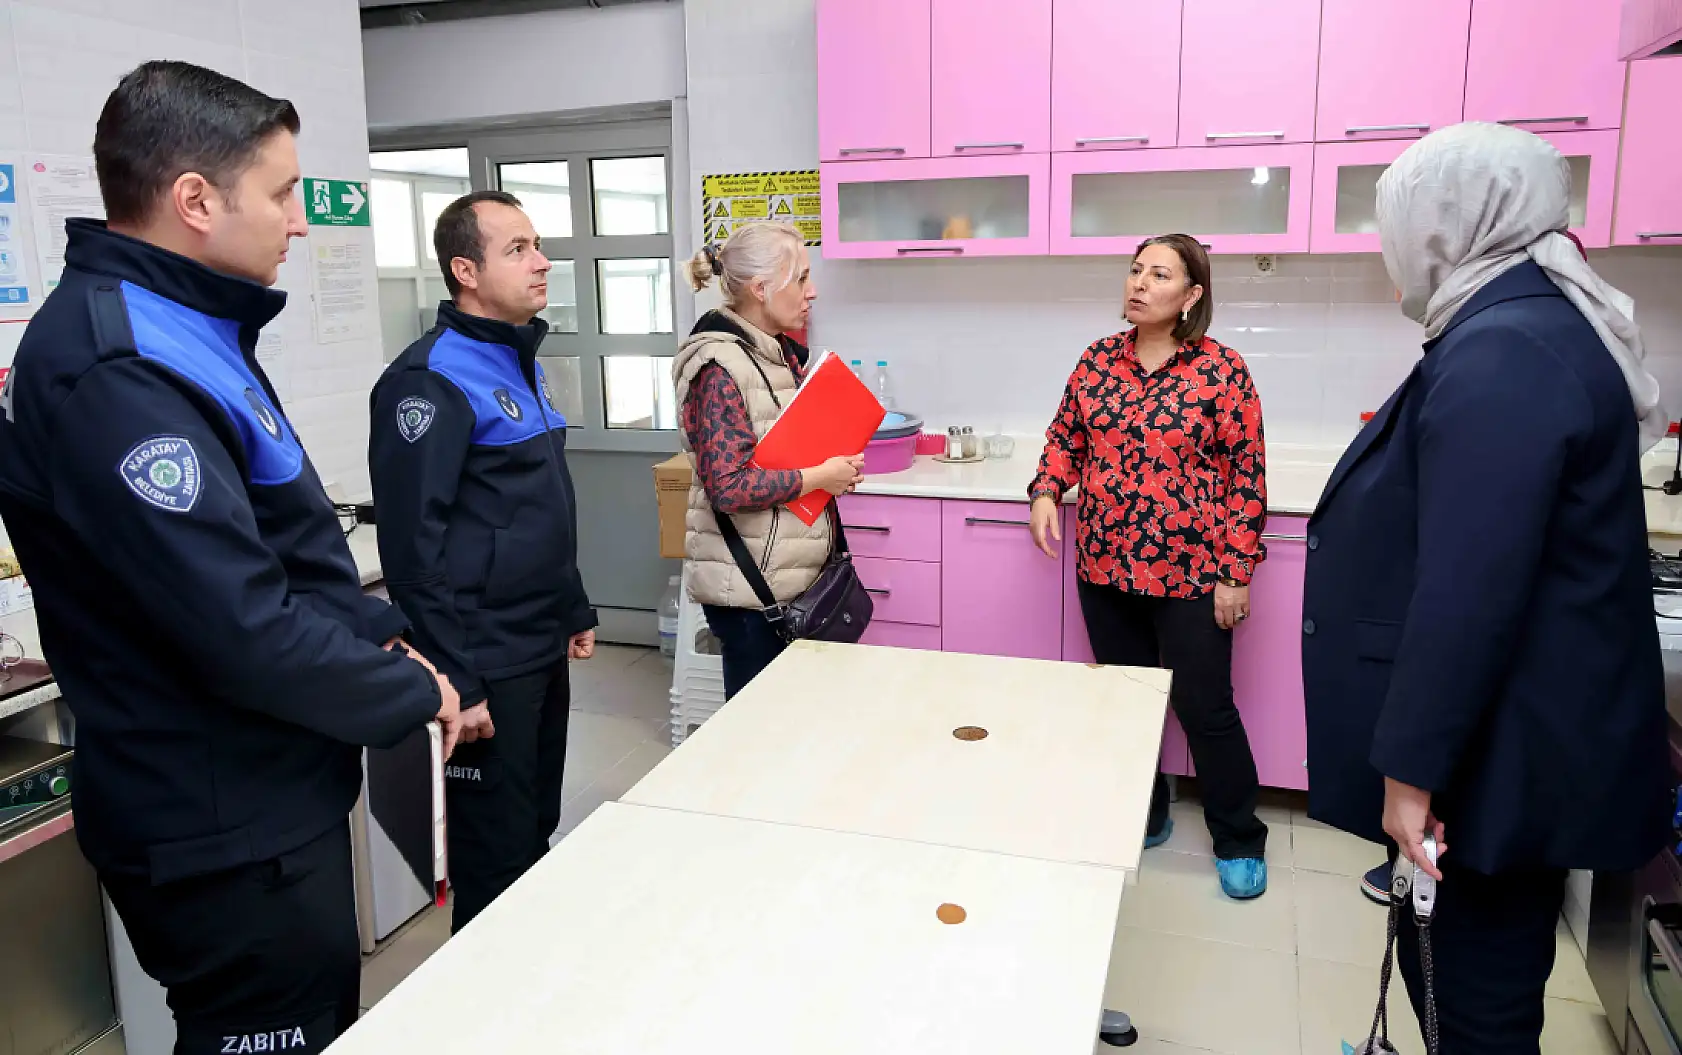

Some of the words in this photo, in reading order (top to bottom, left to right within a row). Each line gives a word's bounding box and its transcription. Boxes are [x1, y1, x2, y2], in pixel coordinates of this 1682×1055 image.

[128, 442, 181, 472] KARATAY
[445, 765, 482, 781] ABITA
[220, 1026, 306, 1055] ZABITA
